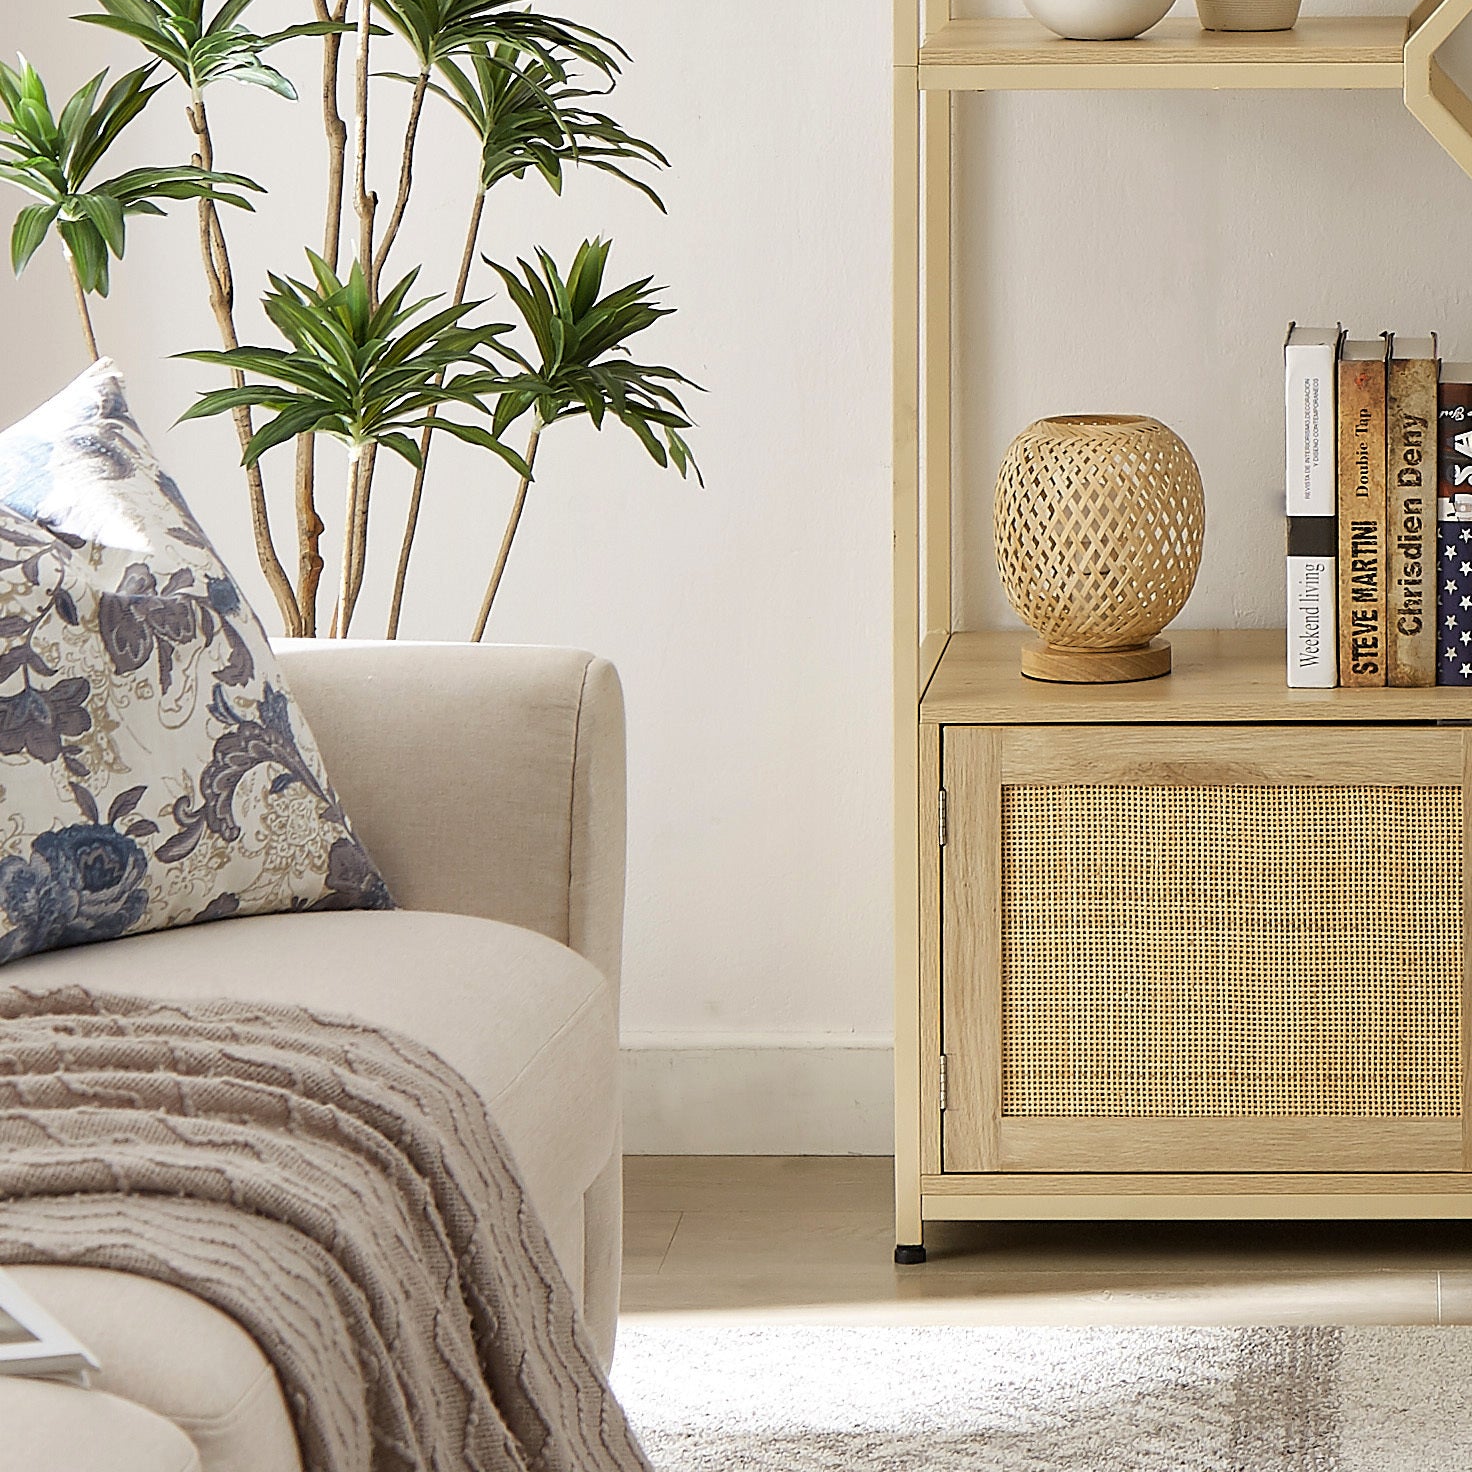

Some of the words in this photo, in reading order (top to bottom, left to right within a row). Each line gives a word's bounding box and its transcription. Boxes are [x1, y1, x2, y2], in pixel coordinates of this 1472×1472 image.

[1397, 413, 1428, 487] Deny
[1299, 563, 1325, 602] living
[1351, 521, 1379, 603] MARTINI
[1397, 499, 1423, 637] Chrisdien
[1299, 606, 1320, 669] Weekend
[1351, 610, 1379, 675] STEVE
